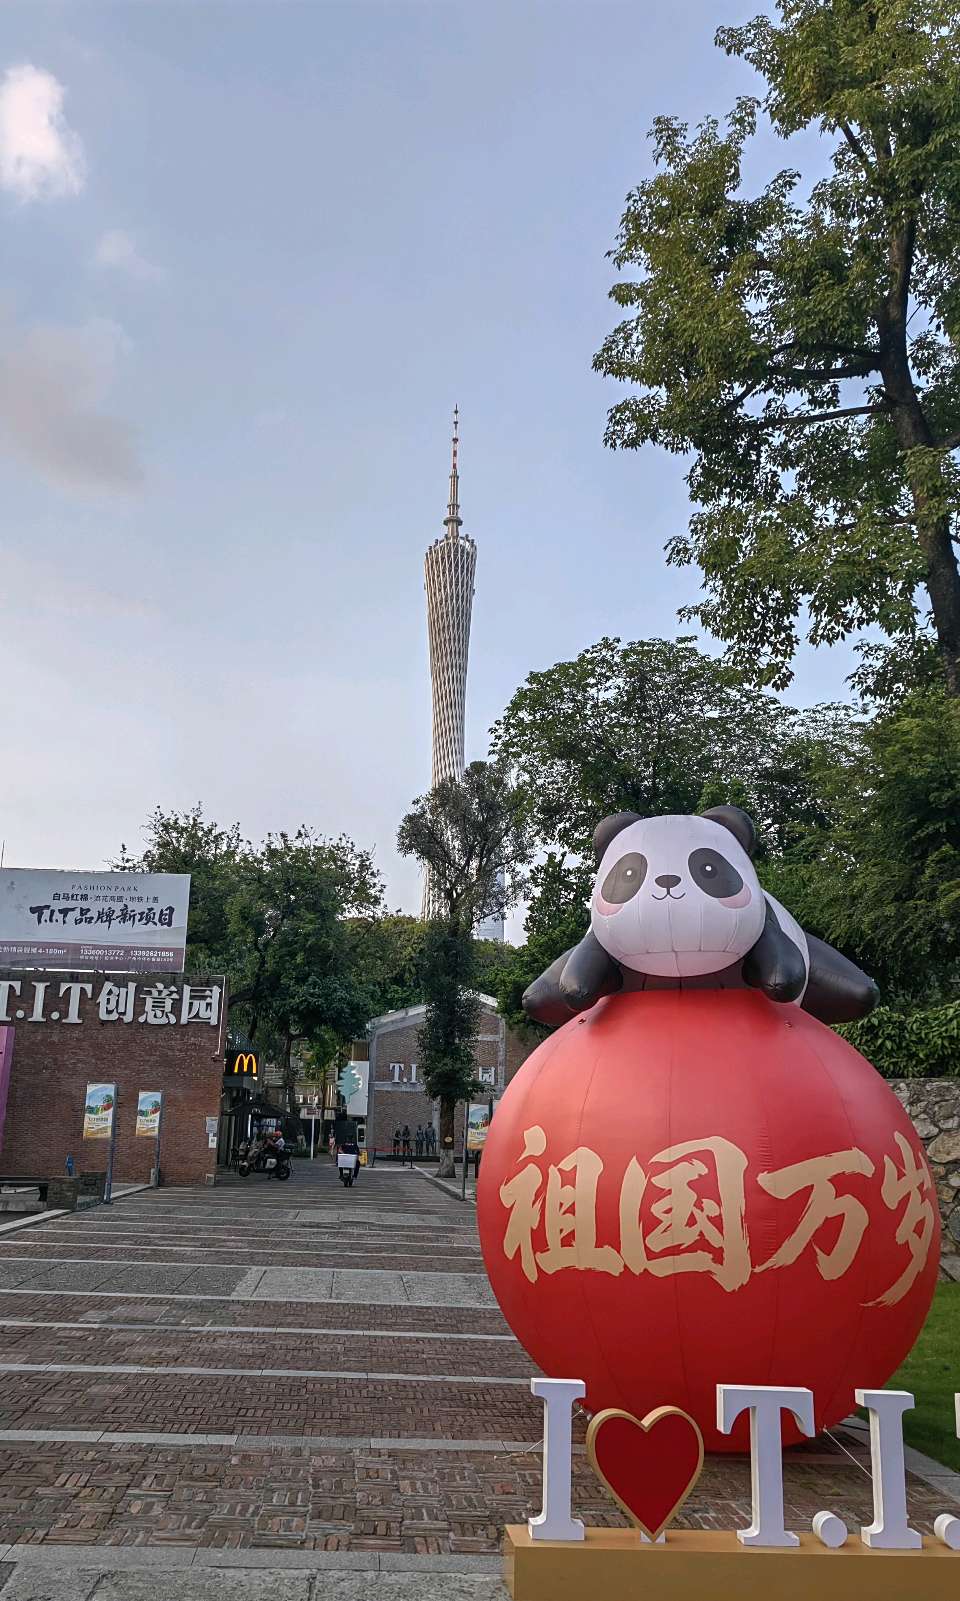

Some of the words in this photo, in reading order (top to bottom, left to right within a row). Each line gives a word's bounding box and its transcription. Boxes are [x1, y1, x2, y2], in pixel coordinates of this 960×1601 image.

[29, 904, 175, 930] T.I.T品牌新项目
[500, 1125, 936, 1308] 祖国万岁
[528, 1377, 586, 1541] I
